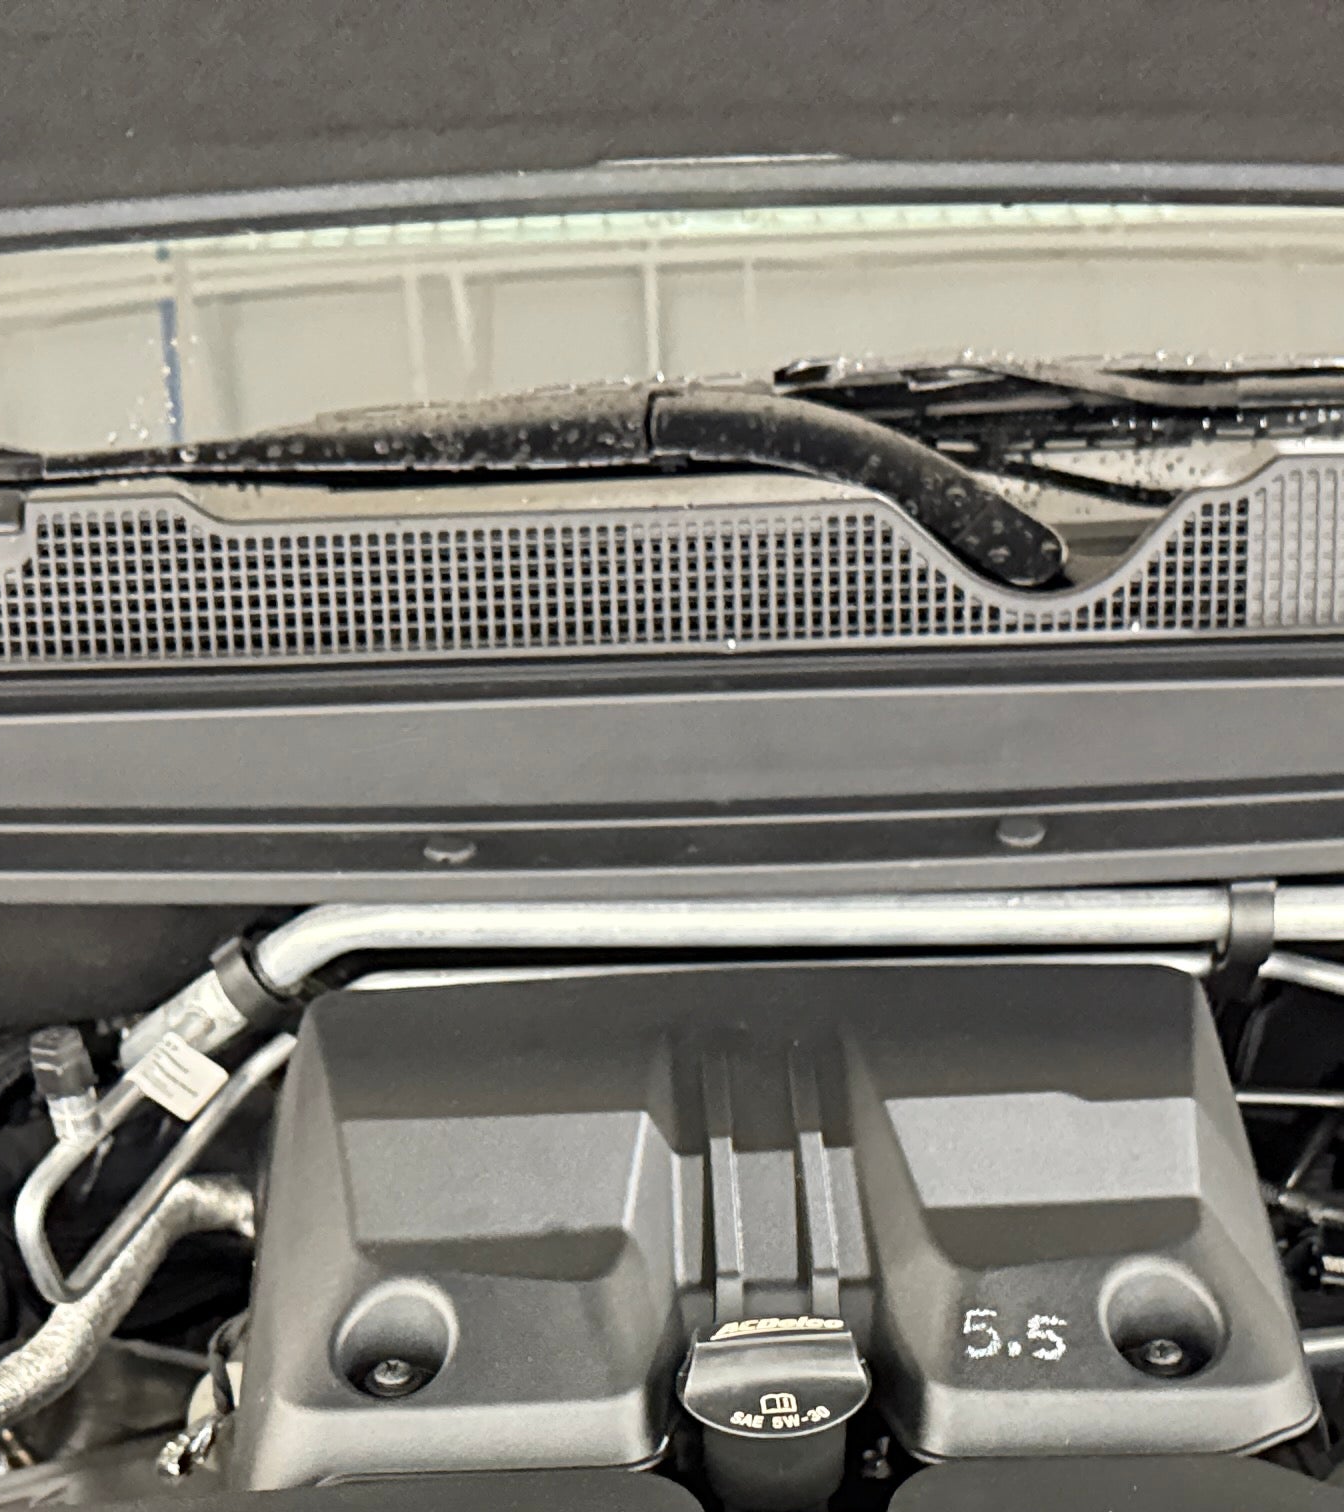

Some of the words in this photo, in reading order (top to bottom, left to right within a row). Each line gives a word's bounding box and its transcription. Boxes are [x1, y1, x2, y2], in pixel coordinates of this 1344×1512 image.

[711, 1315, 845, 1339] ACDelco
[963, 1308, 1068, 1361] 5.5
[729, 1411, 765, 1429] SAE
[772, 1405, 831, 1430] 5W-30
